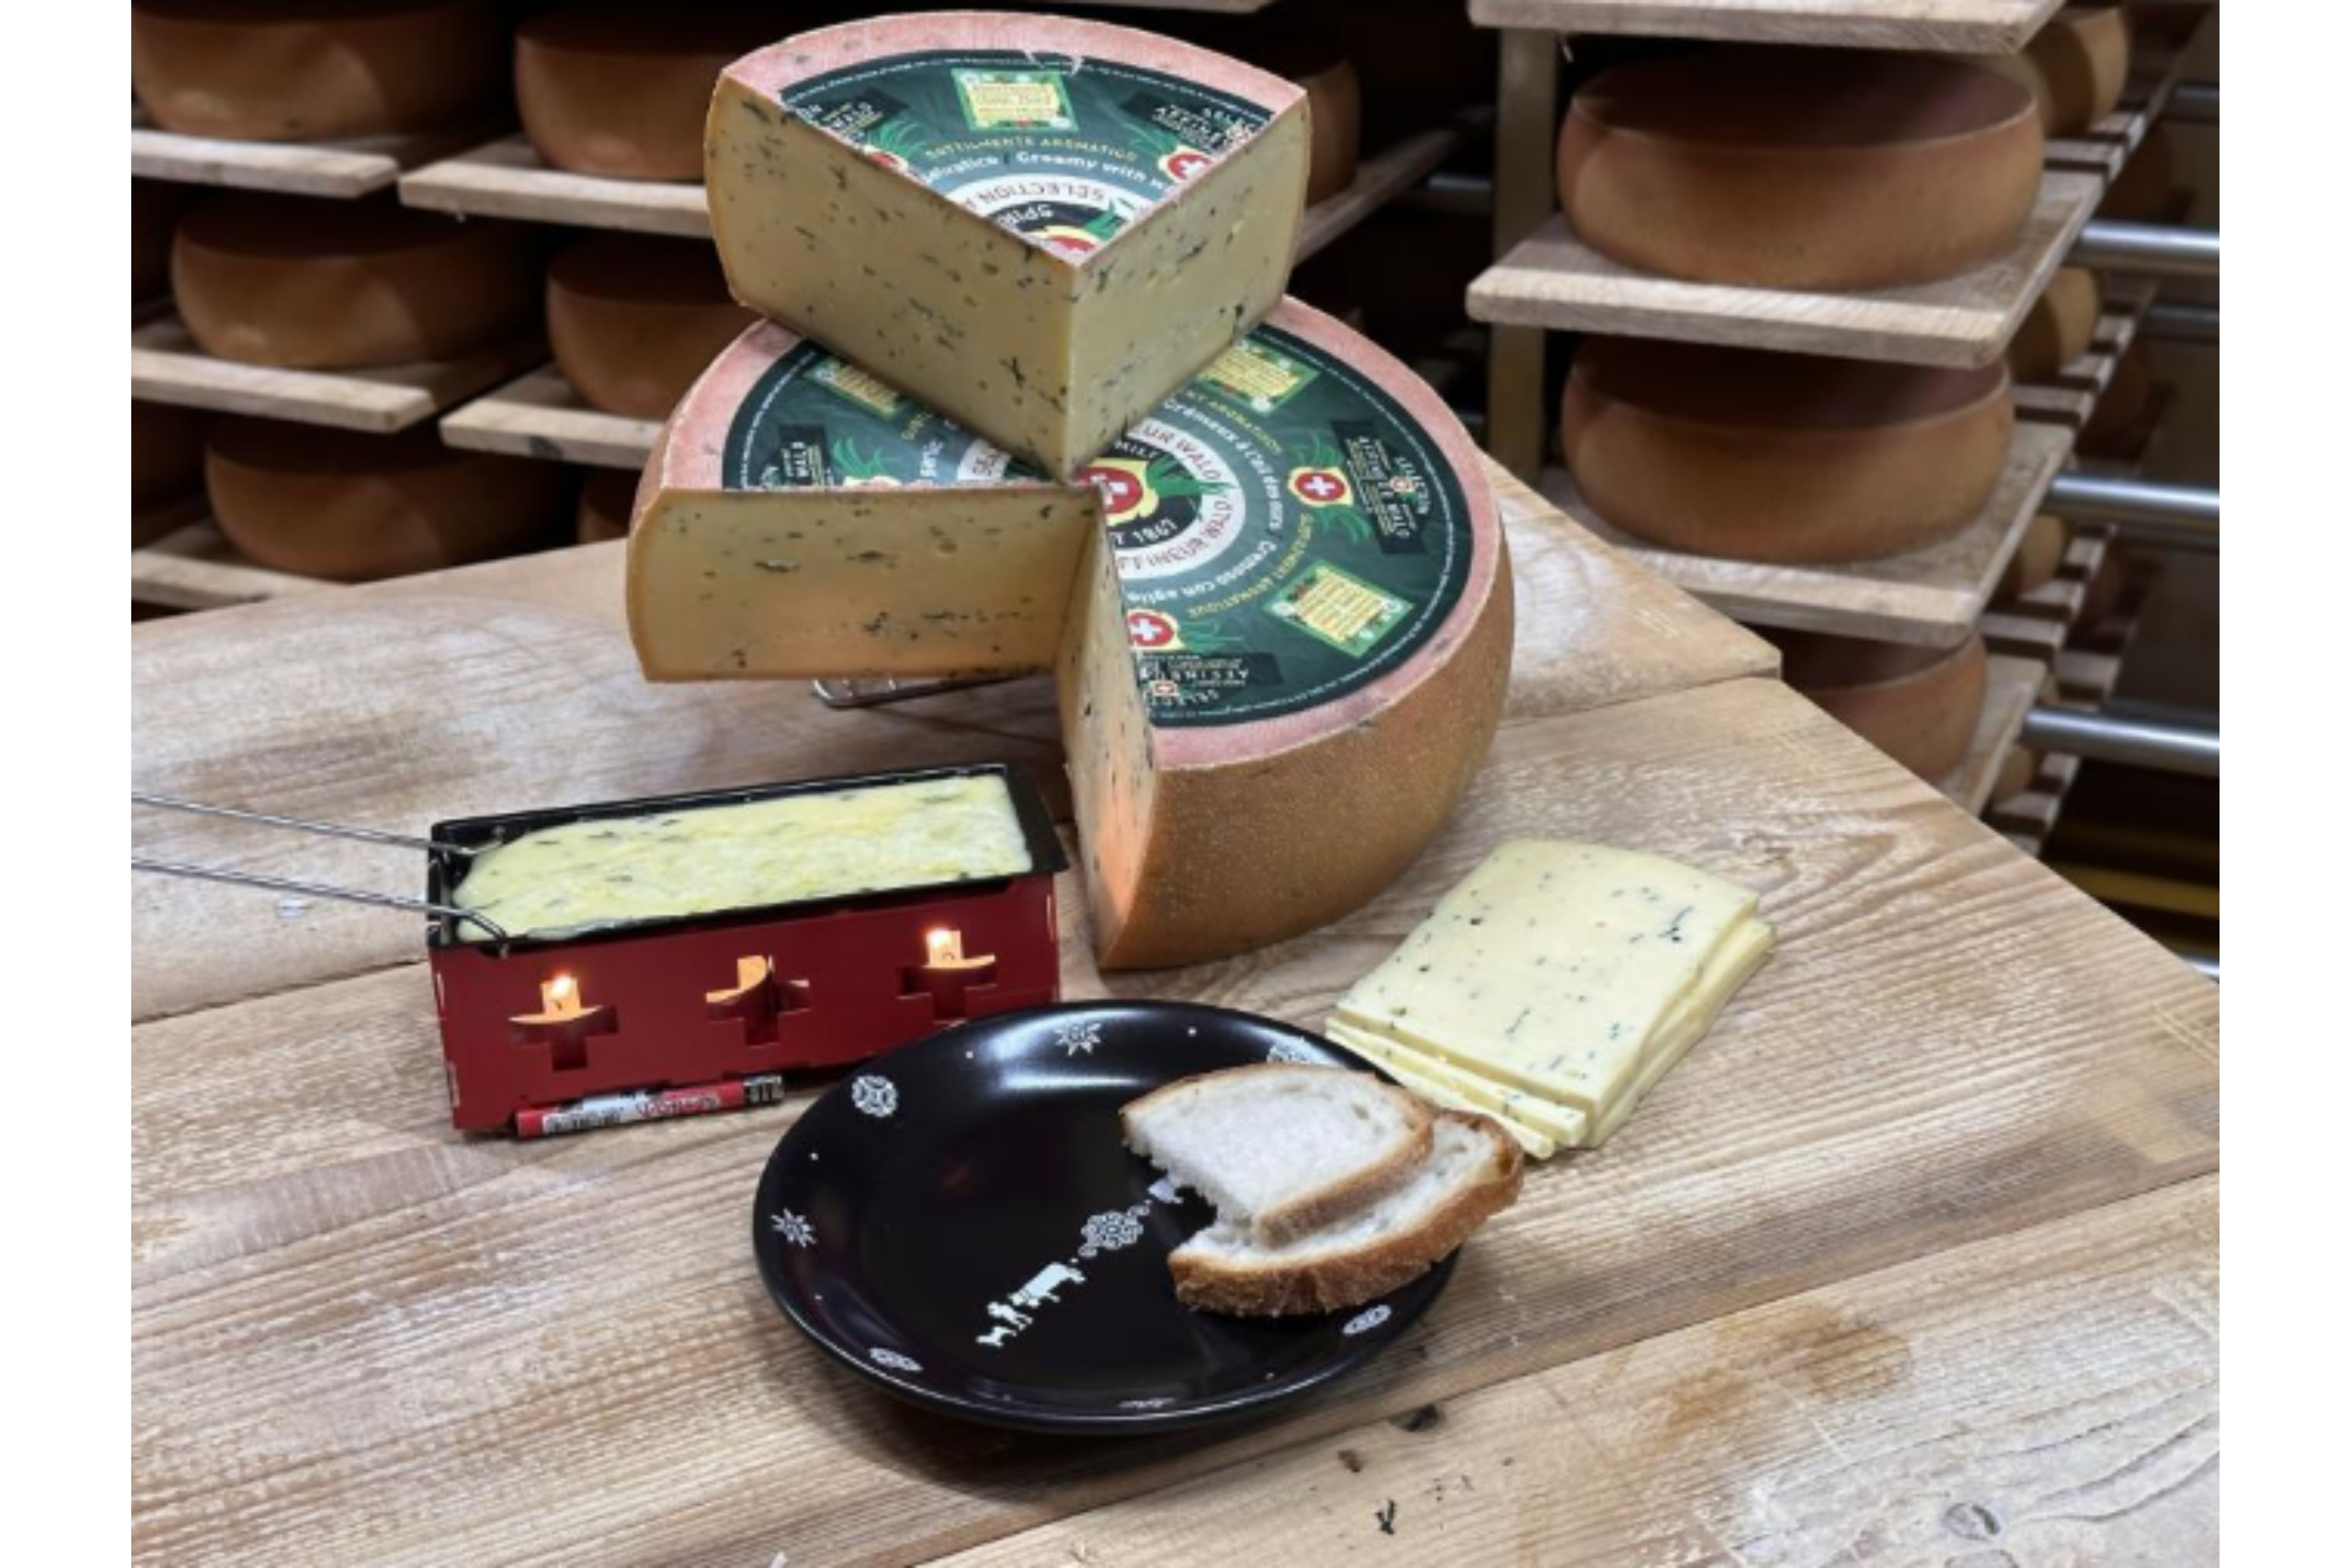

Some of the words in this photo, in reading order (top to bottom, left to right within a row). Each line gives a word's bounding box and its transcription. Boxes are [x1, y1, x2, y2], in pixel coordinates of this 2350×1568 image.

[1040, 138, 1138, 161] AROMATICO
[1017, 150, 1099, 169] Creamy
[1102, 160, 1146, 183] with
[978, 182, 1104, 205] SELECTION
